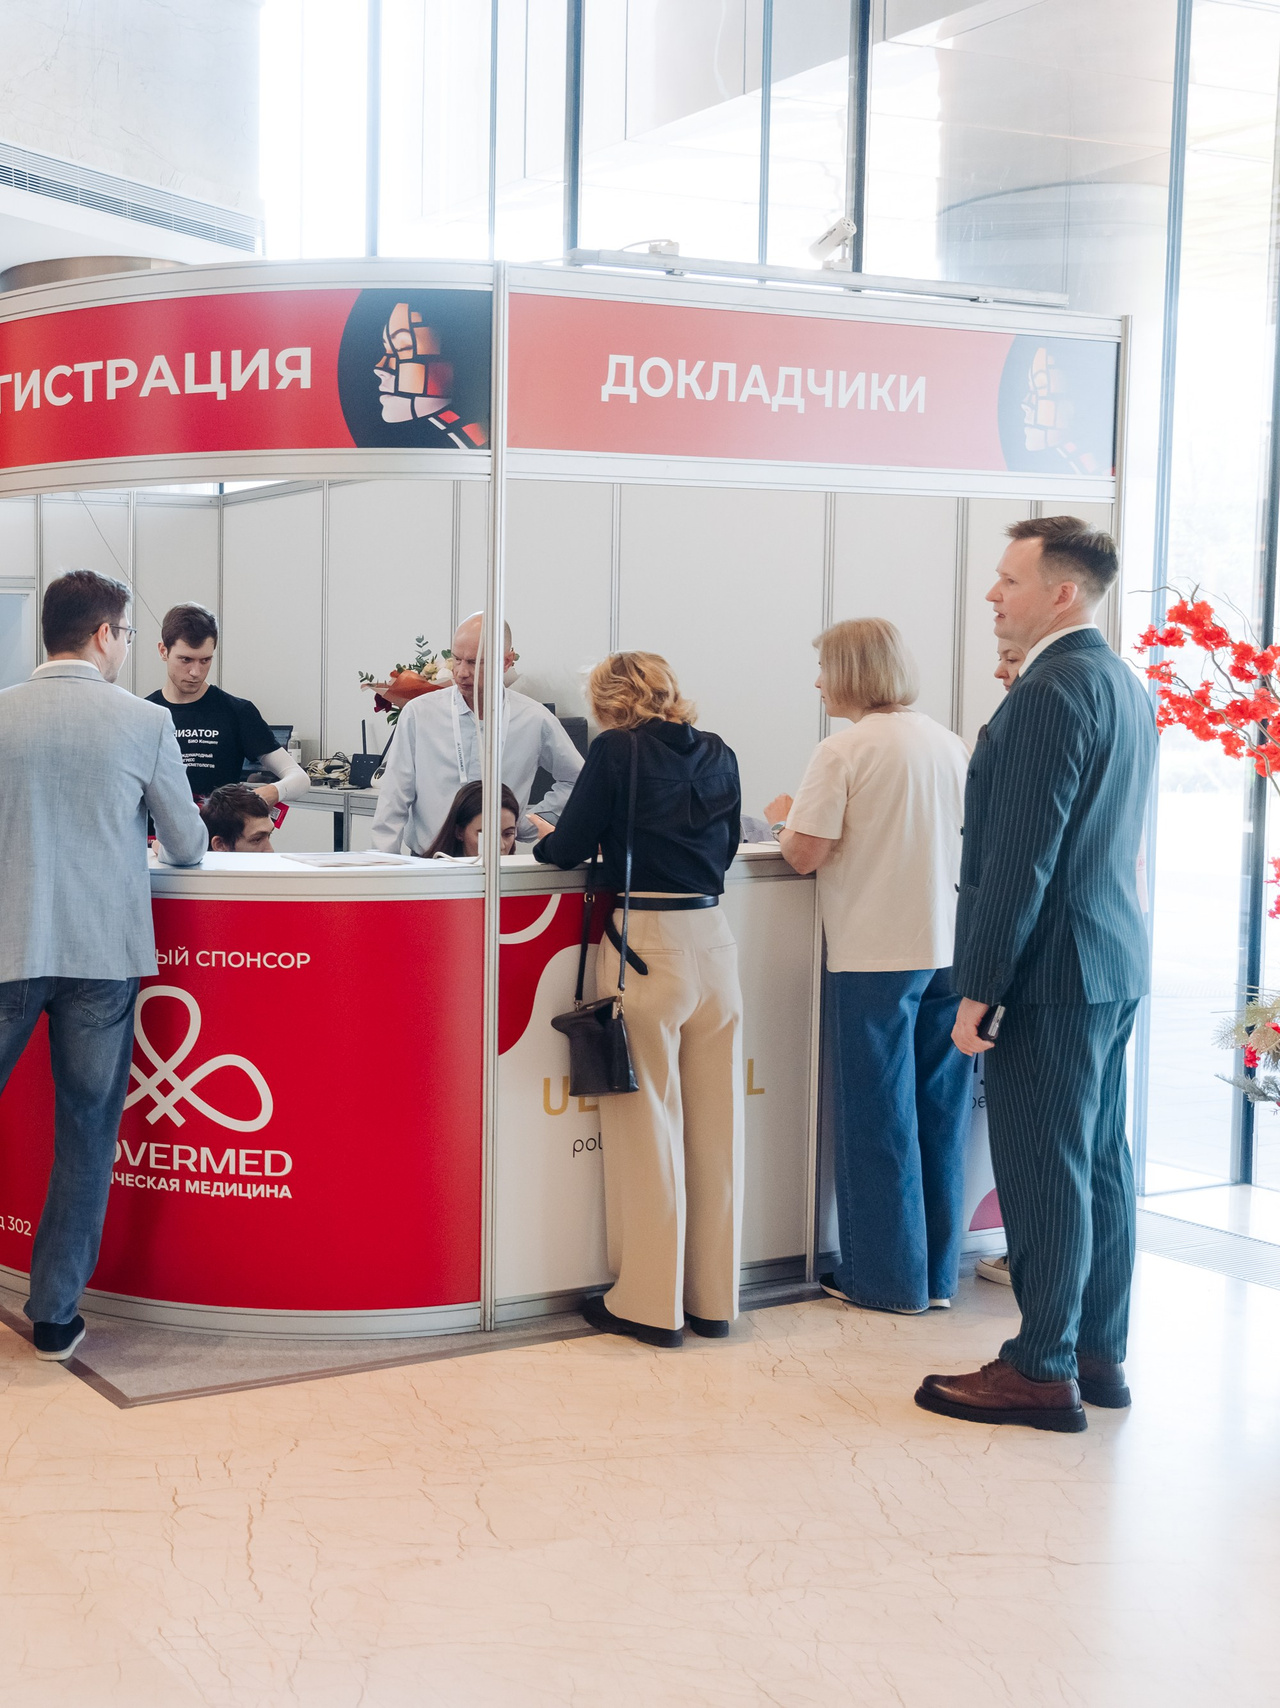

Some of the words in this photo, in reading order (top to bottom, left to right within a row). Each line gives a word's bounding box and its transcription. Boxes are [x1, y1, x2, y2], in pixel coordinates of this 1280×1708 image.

[601, 354, 927, 414] ДОКЛАДЧИКИ
[174, 729, 219, 738] НИЗАТОР
[196, 950, 311, 969] СПОНСОР
[114, 1139, 293, 1177] VERMED
[111, 1171, 180, 1192] ЧЕСКАЯ
[185, 1179, 293, 1199] МЕДИЦИНА
[7, 1215, 32, 1236] 302
